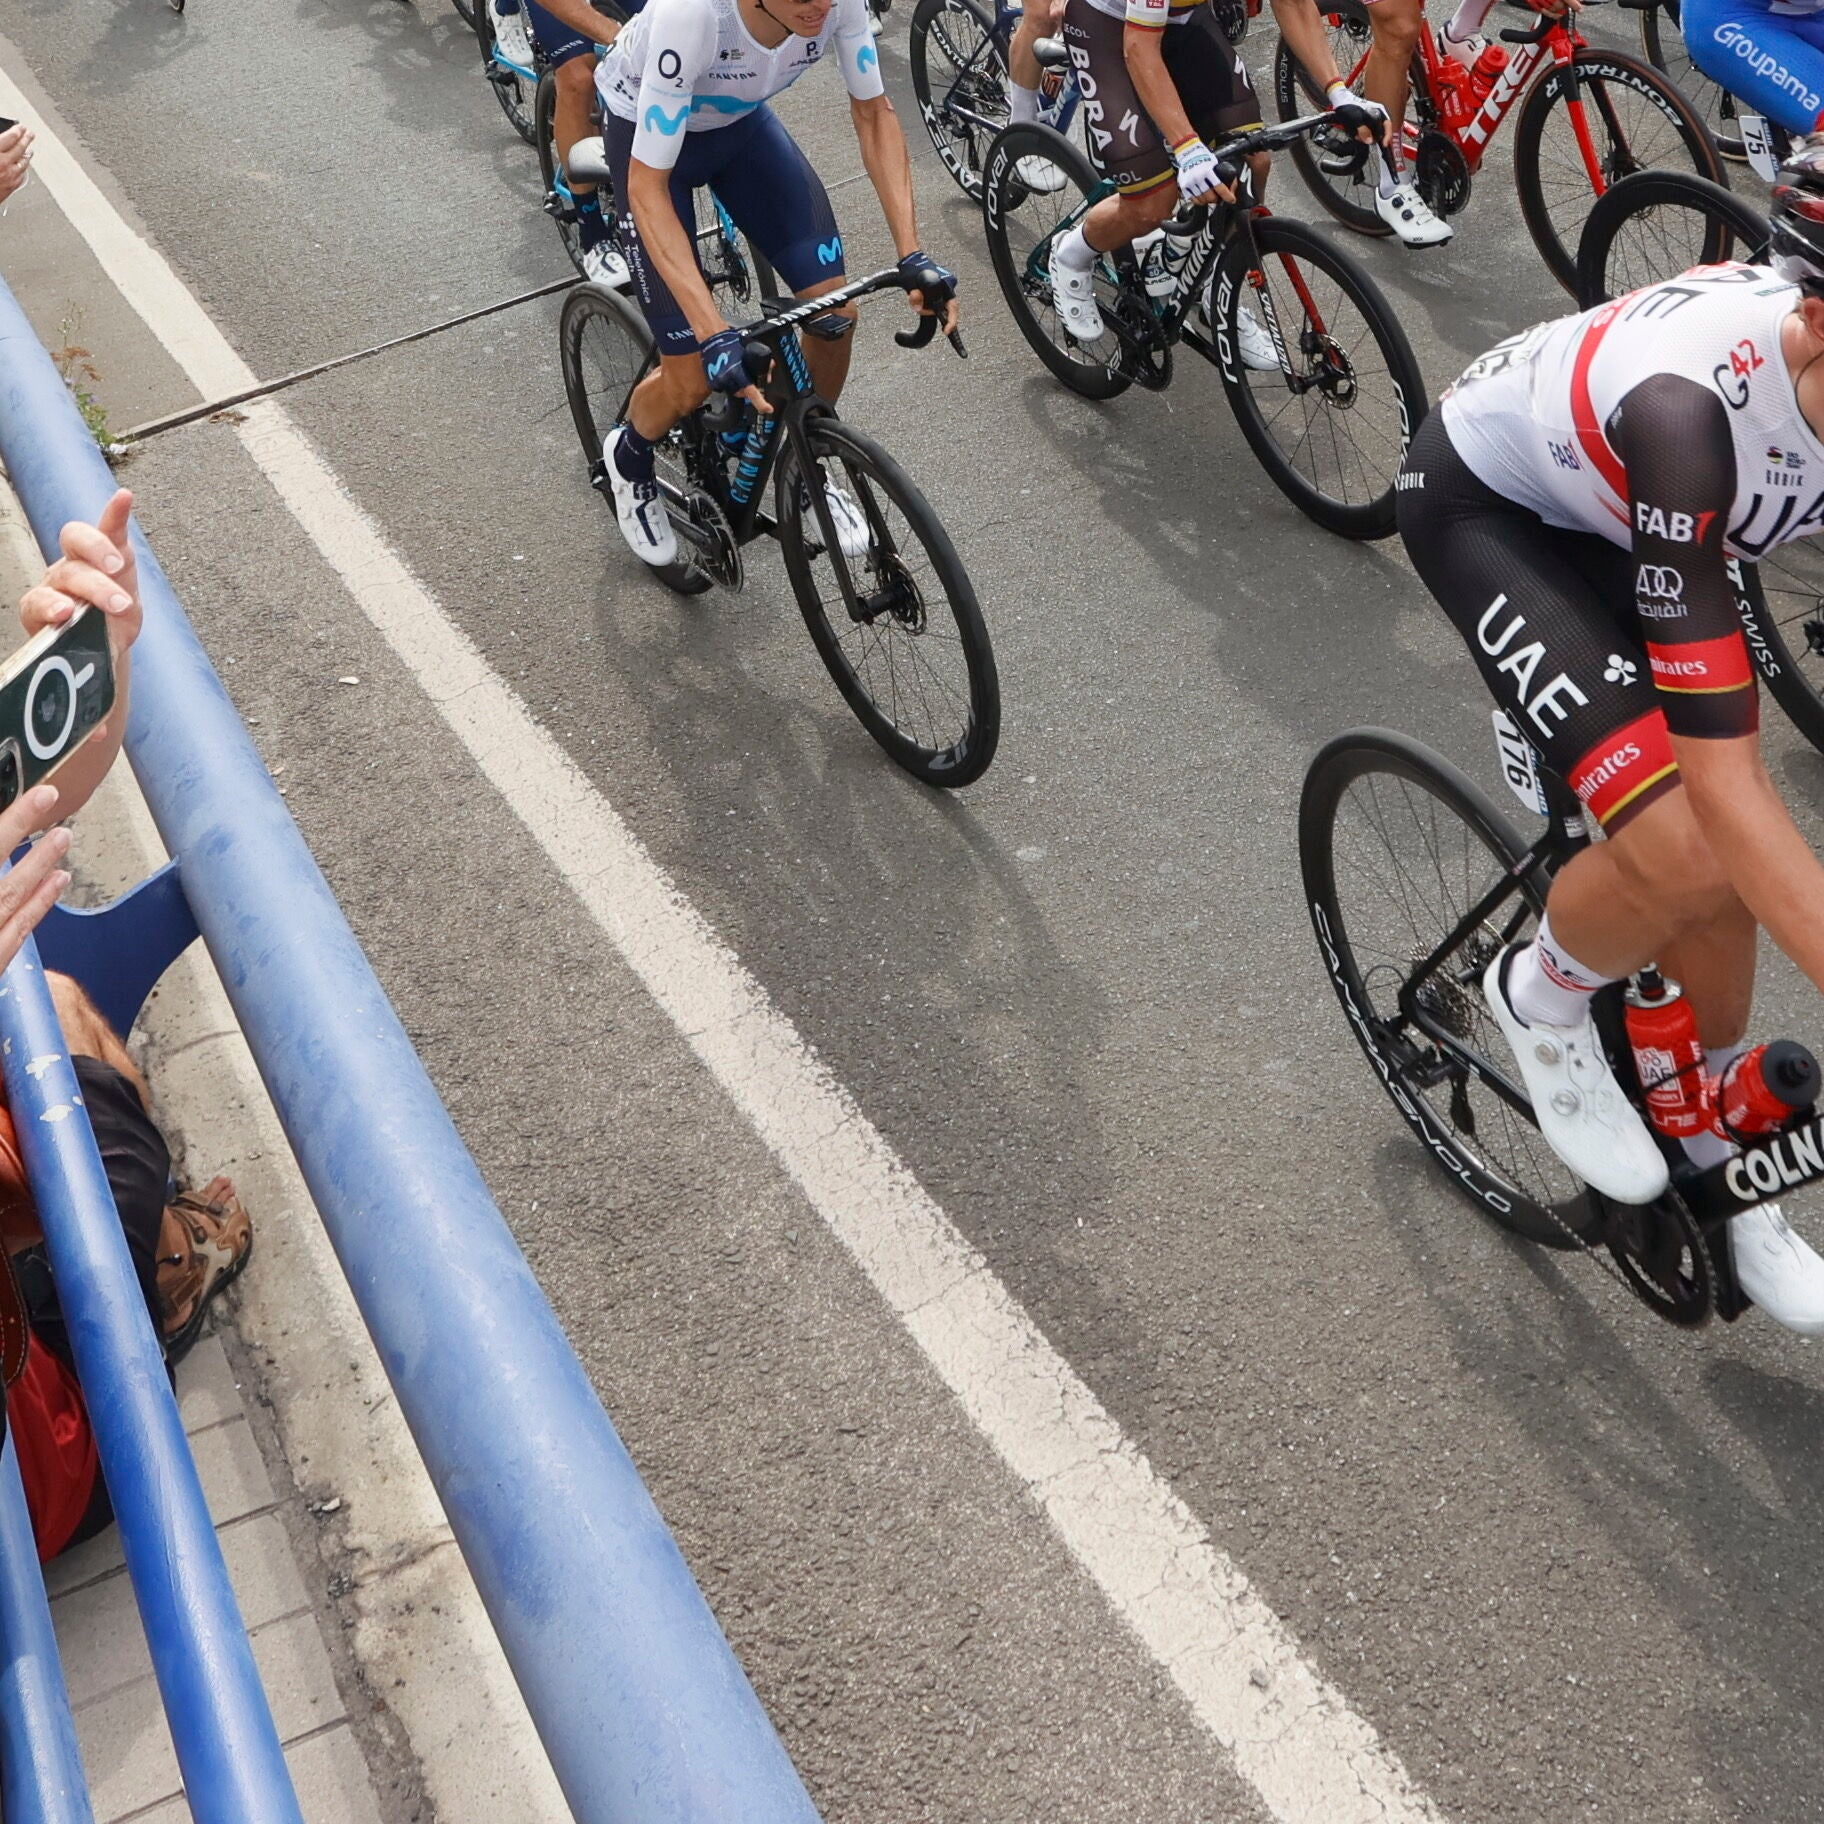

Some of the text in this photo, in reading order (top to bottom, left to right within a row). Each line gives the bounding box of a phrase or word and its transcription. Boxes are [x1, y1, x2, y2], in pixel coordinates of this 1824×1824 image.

[1067, 45, 1113, 153] BORA
[1279, 52, 1289, 105] AEOLUS
[1712, 22, 1821, 112] Groupama
[1744, 128, 1767, 156] 75
[988, 146, 1007, 231] roval
[631, 243, 652, 304] Telefónica
[1712, 337, 1766, 411] G42
[1635, 563, 1684, 602] ADQ
[1475, 592, 1590, 740] UAE
[1734, 597, 1782, 678] SWISS
[1496, 724, 1534, 792] 176
